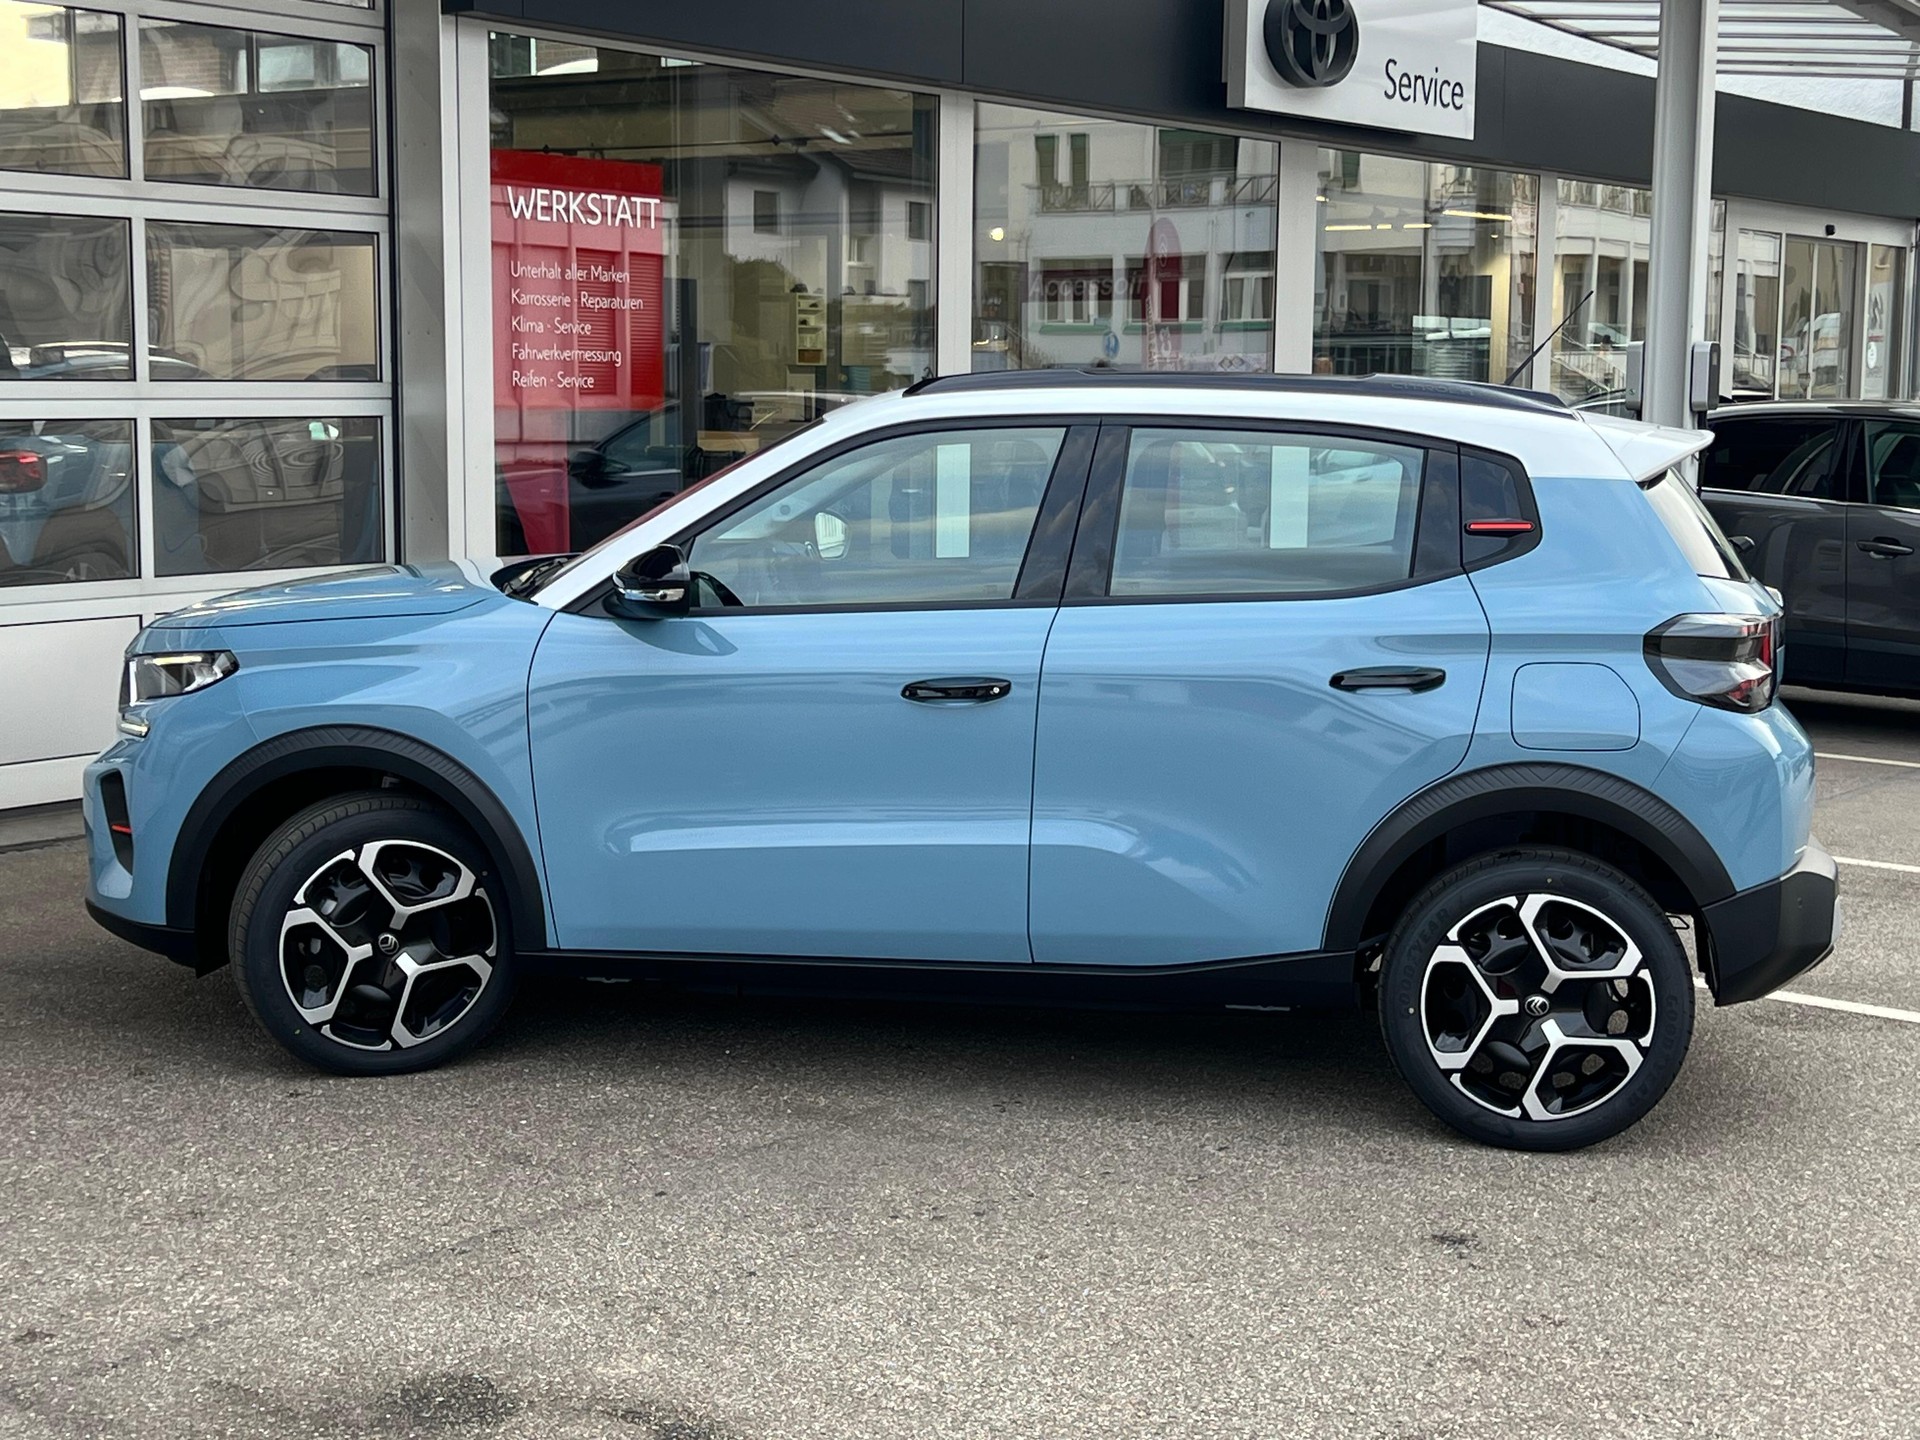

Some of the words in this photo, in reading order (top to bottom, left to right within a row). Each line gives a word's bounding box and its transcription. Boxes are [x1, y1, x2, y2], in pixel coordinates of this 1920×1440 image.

[1384, 58, 1464, 110] Service
[507, 185, 661, 229] WERKSTATT
[510, 260, 562, 280] Unterhalt
[564, 264, 588, 281] aller
[590, 265, 630, 283] Marken
[511, 288, 571, 307] Karrosserie
[580, 291, 644, 312] Reparaturen
[511, 315, 544, 333] Klima
[554, 317, 592, 335] Service
[512, 342, 622, 367] Fahrwerkvermessung
[512, 369, 547, 388] Reifen
[557, 371, 595, 388] Service
